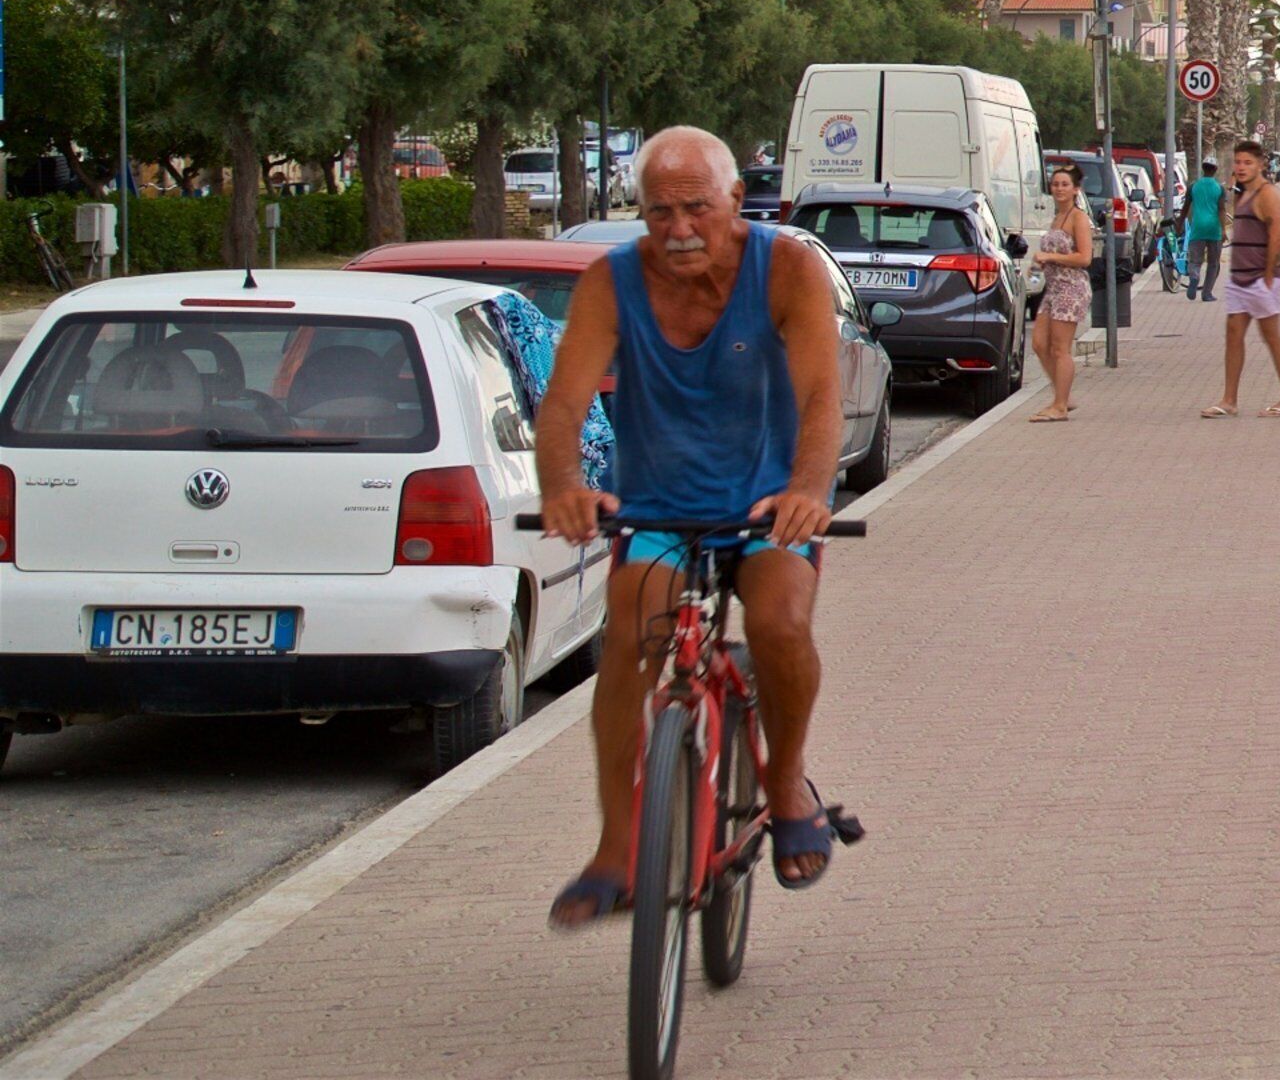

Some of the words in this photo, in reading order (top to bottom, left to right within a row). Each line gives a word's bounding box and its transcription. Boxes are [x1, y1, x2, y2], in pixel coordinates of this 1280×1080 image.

[1189, 71, 1211, 89] 50
[867, 272, 907, 284] 770MN
[116, 614, 155, 644] CN
[173, 614, 273, 644] 185EJ
